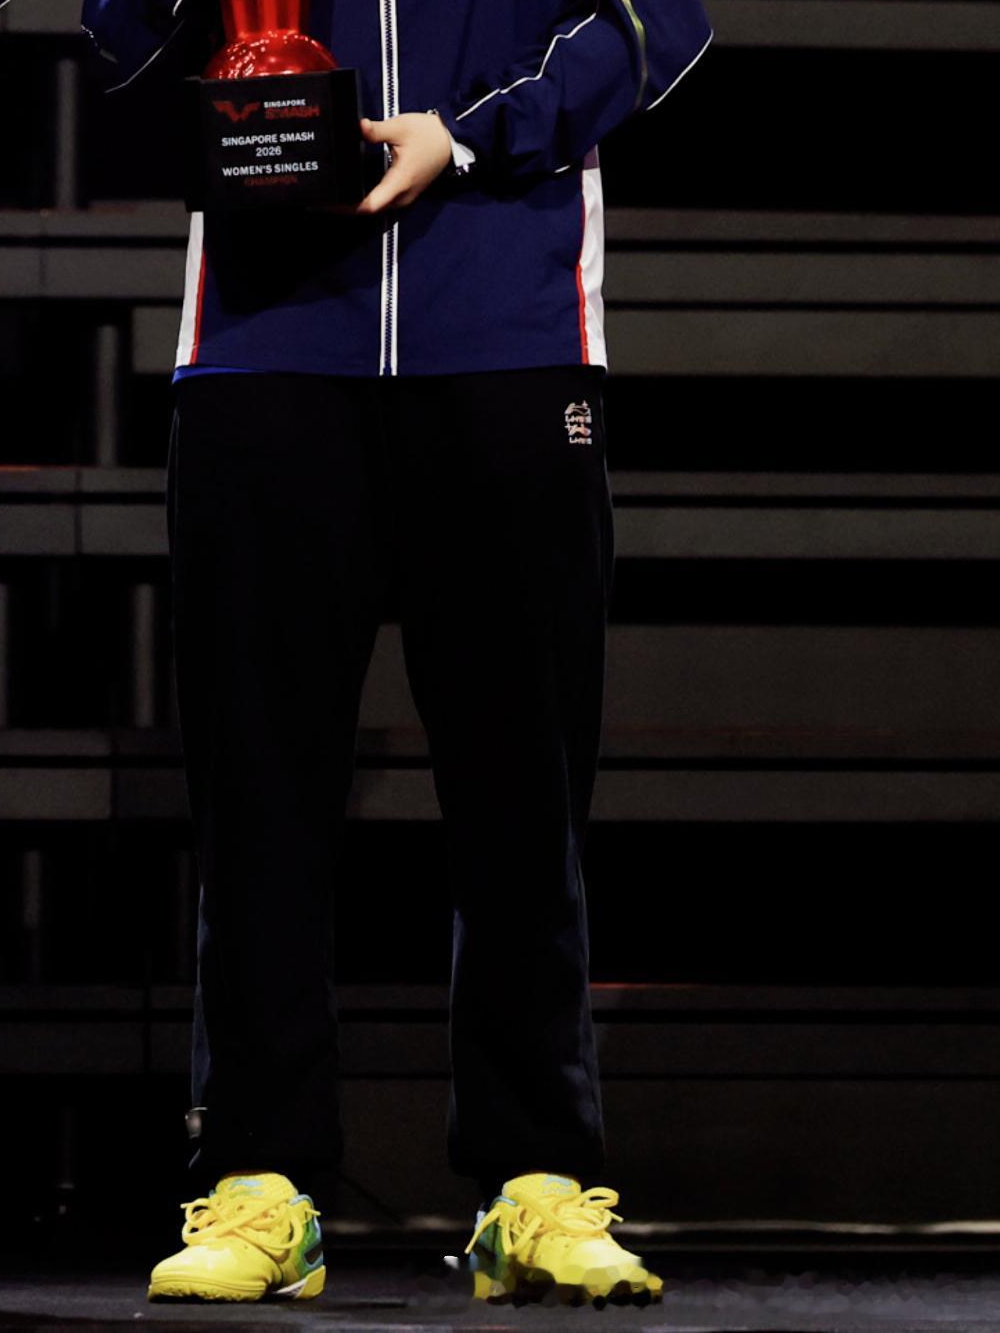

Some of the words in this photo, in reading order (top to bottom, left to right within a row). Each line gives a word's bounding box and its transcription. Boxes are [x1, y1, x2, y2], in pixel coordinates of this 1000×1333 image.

[264, 99, 306, 108] SINGAPORE
[221, 134, 278, 146] SINGAPORE
[280, 131, 315, 143] SMASH
[256, 146, 282, 157] 2026
[222, 165, 272, 176] WOMEN'S
[274, 161, 319, 174] SINGLES
